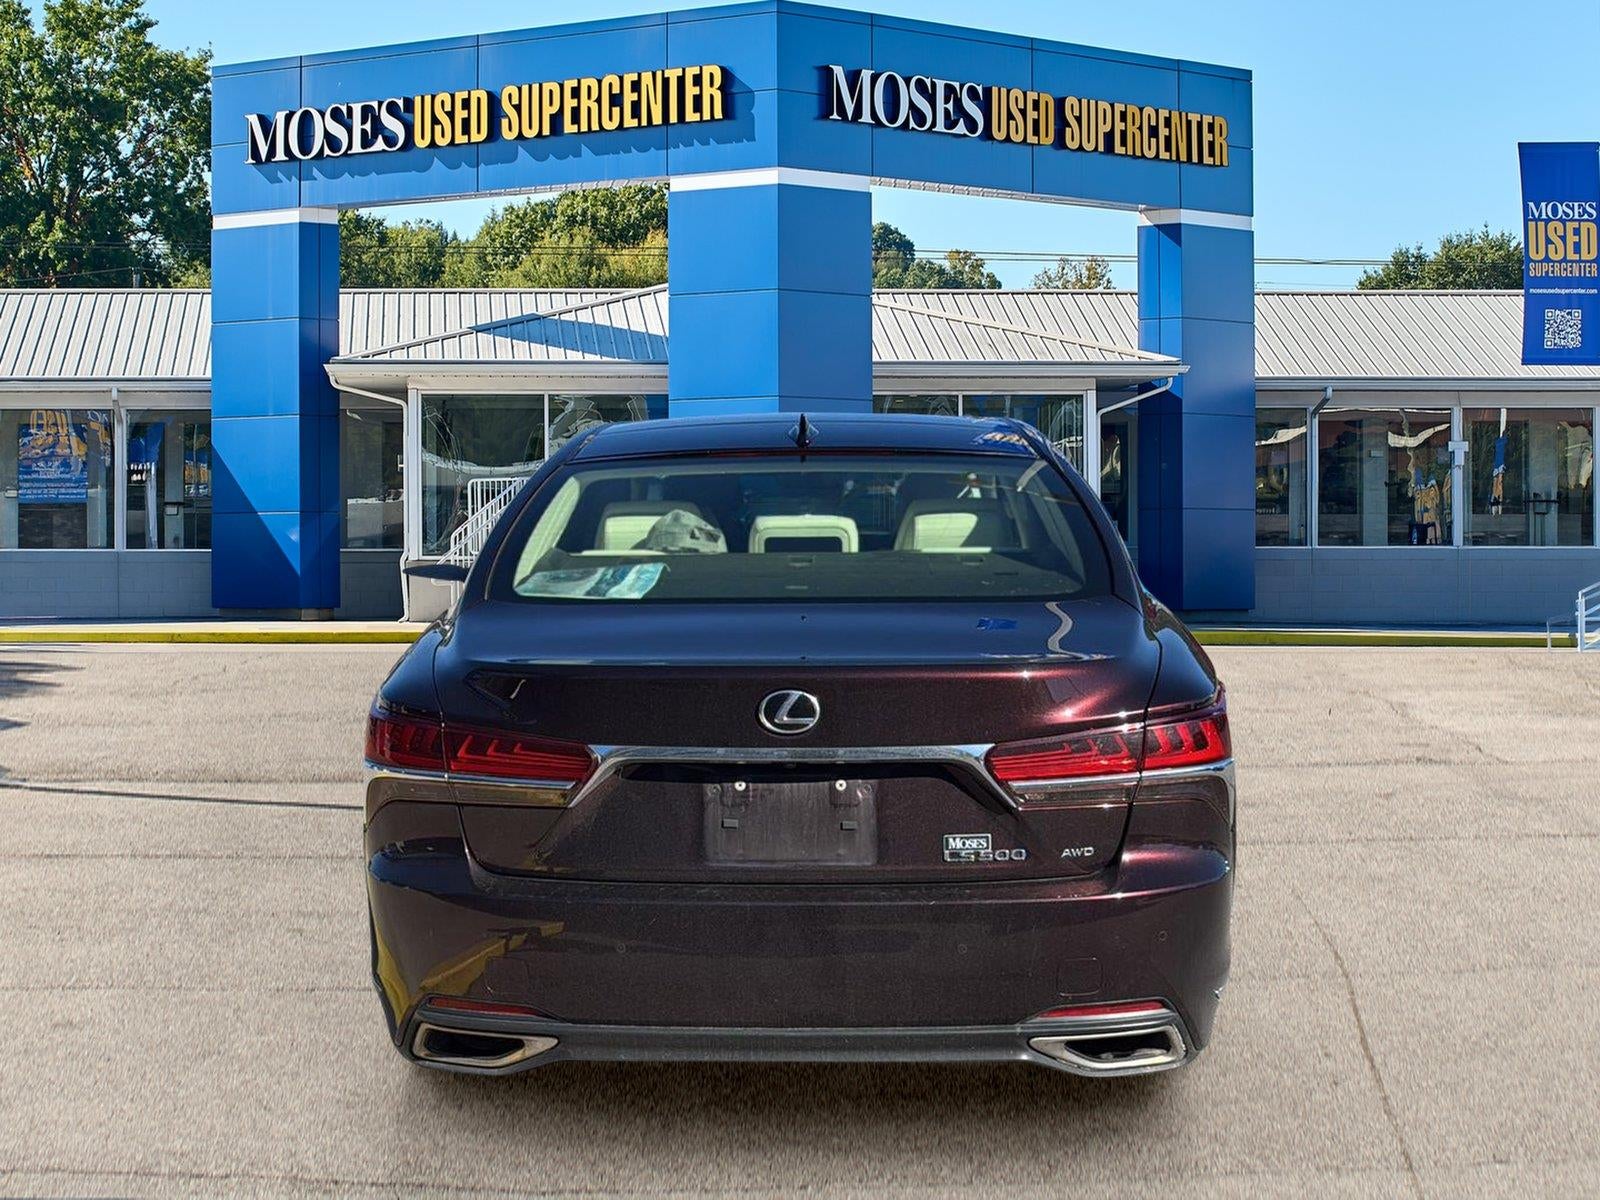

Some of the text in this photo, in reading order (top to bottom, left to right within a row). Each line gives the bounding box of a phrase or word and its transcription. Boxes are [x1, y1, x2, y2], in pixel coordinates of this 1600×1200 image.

[244, 64, 724, 164] MOSES USED SUPERCENTER
[829, 64, 1230, 167] MOSES USED SUPERCENTER
[1527, 201, 1597, 220] MOSES
[1527, 220, 1598, 261] USED
[1528, 262, 1598, 278] SUPERCENTER
[1529, 287, 1598, 295] mosesusedsupercenter.com
[948, 837, 987, 850] MOSES
[1061, 847, 1094, 858] AWD
